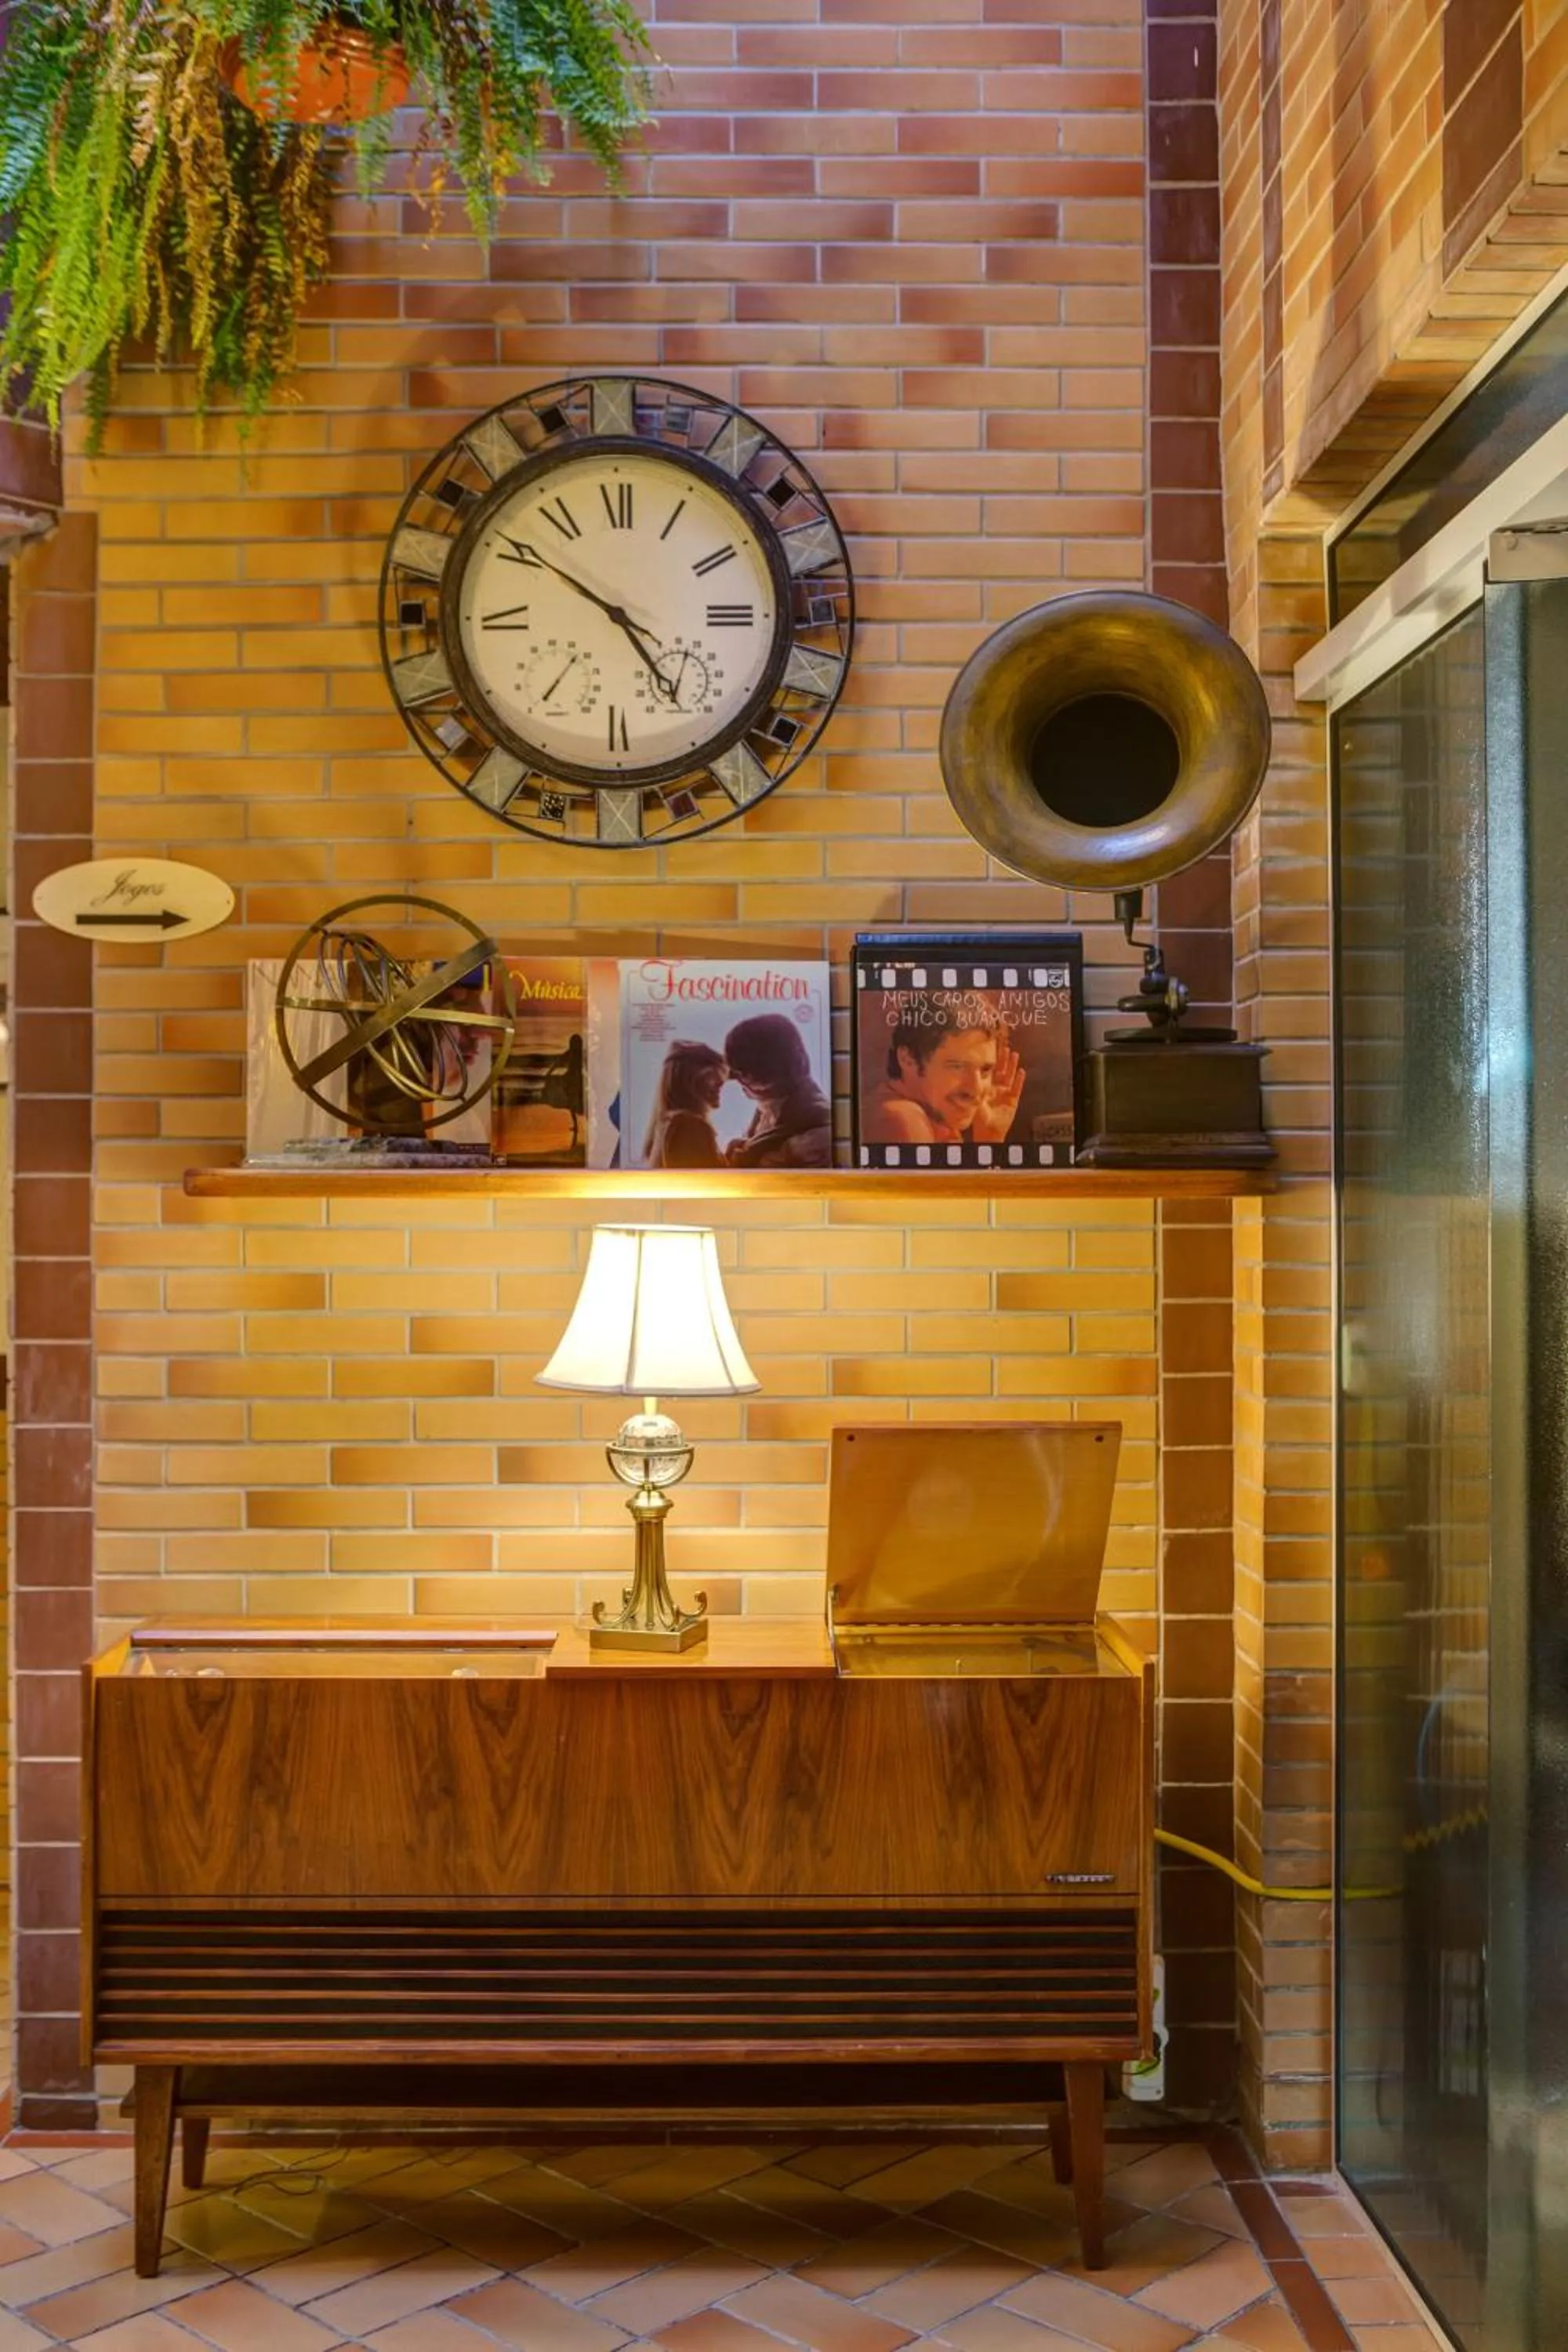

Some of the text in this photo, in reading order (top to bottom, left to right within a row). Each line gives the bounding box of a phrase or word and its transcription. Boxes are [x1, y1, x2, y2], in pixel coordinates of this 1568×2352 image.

[639, 960, 810, 1001] Fascination
[882, 989, 1071, 1012] MEUS CAROS AMIGOS
[885, 1008, 1048, 1030] CHICO BUARQUE
